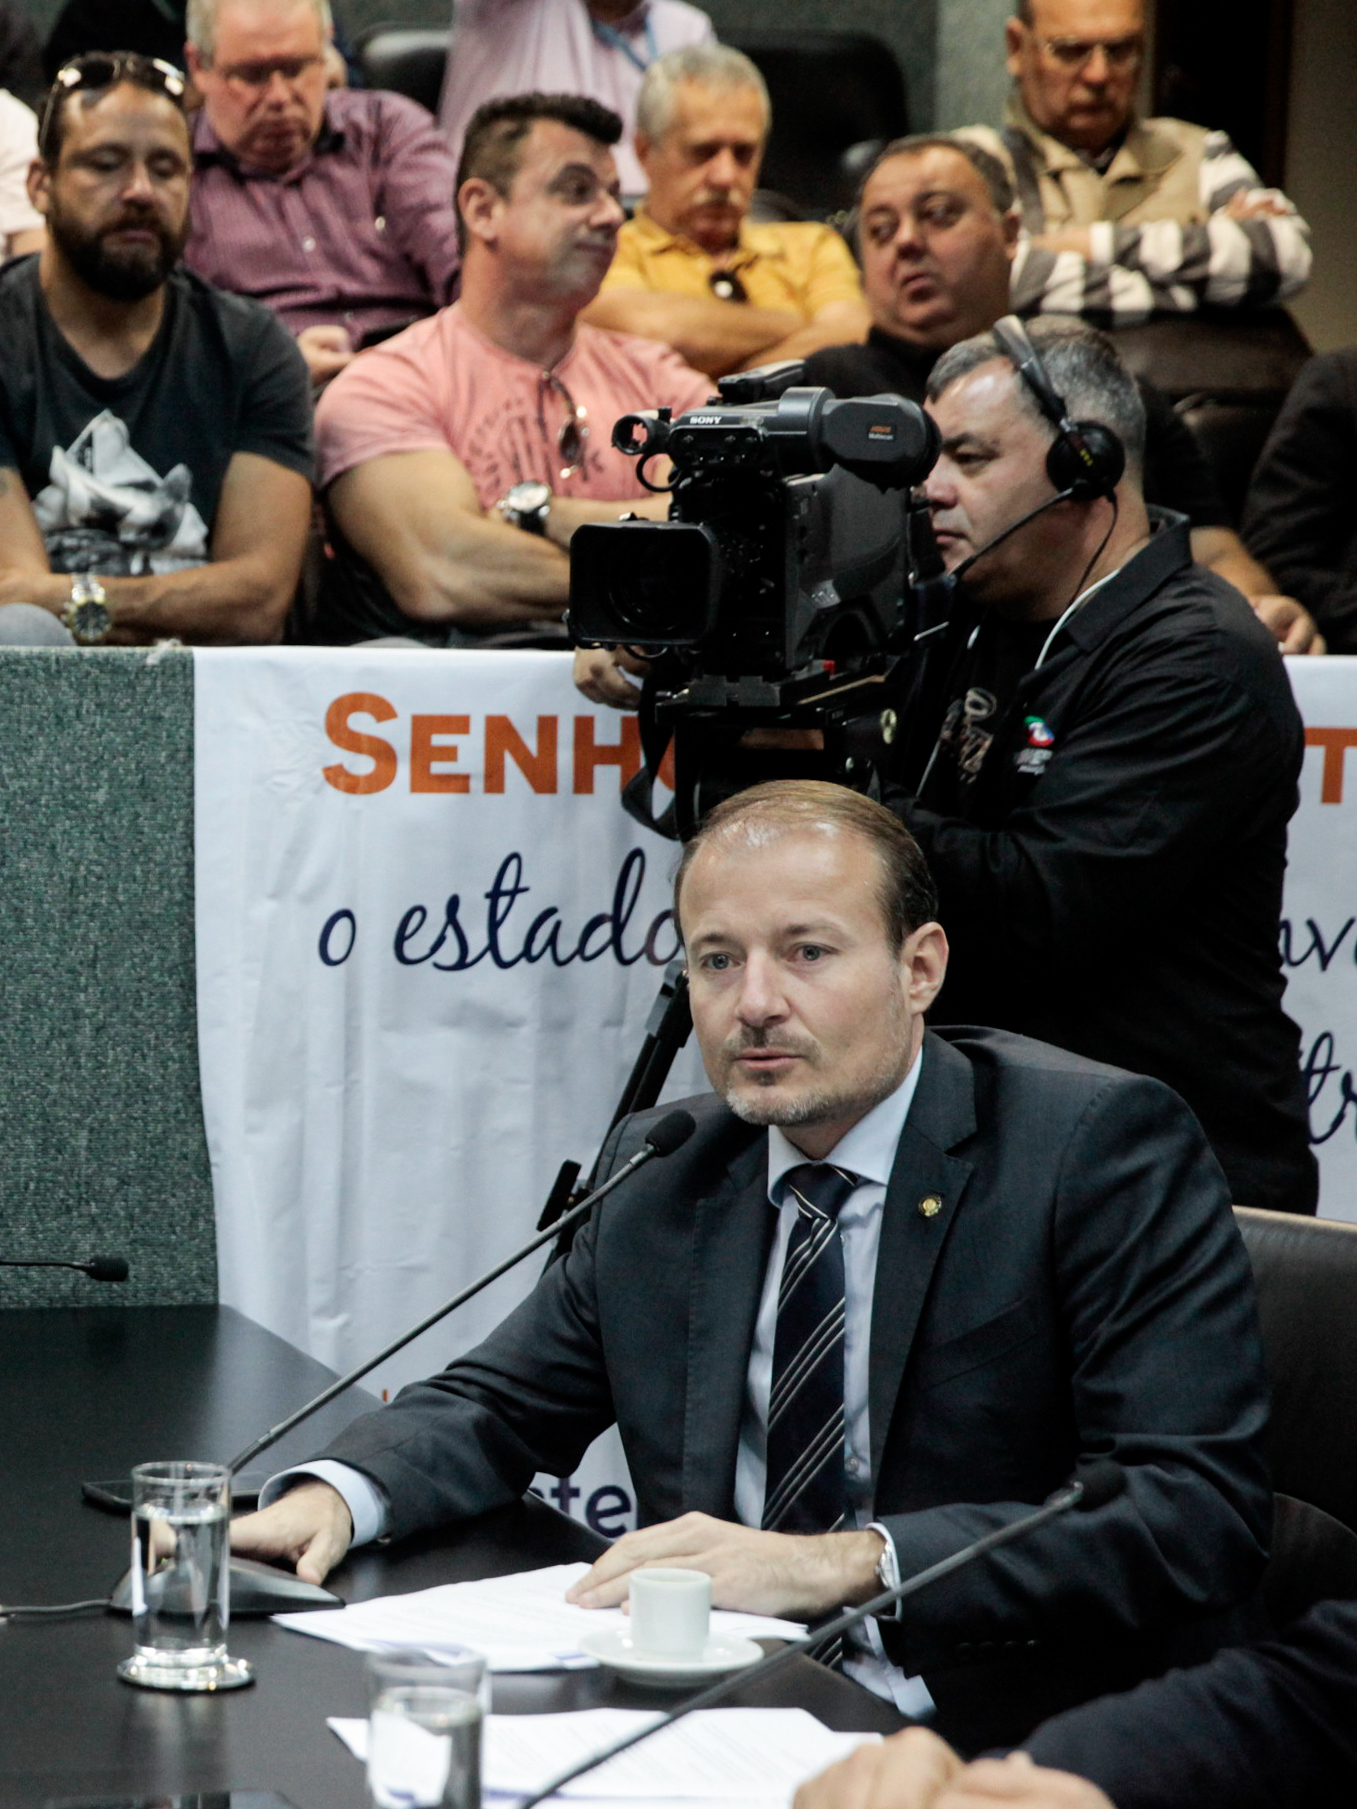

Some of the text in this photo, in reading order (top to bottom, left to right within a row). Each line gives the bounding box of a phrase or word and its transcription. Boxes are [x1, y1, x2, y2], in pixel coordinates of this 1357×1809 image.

[689, 416, 722, 425] SONY
[319, 908, 356, 966] o
[394, 847, 681, 972] estado
